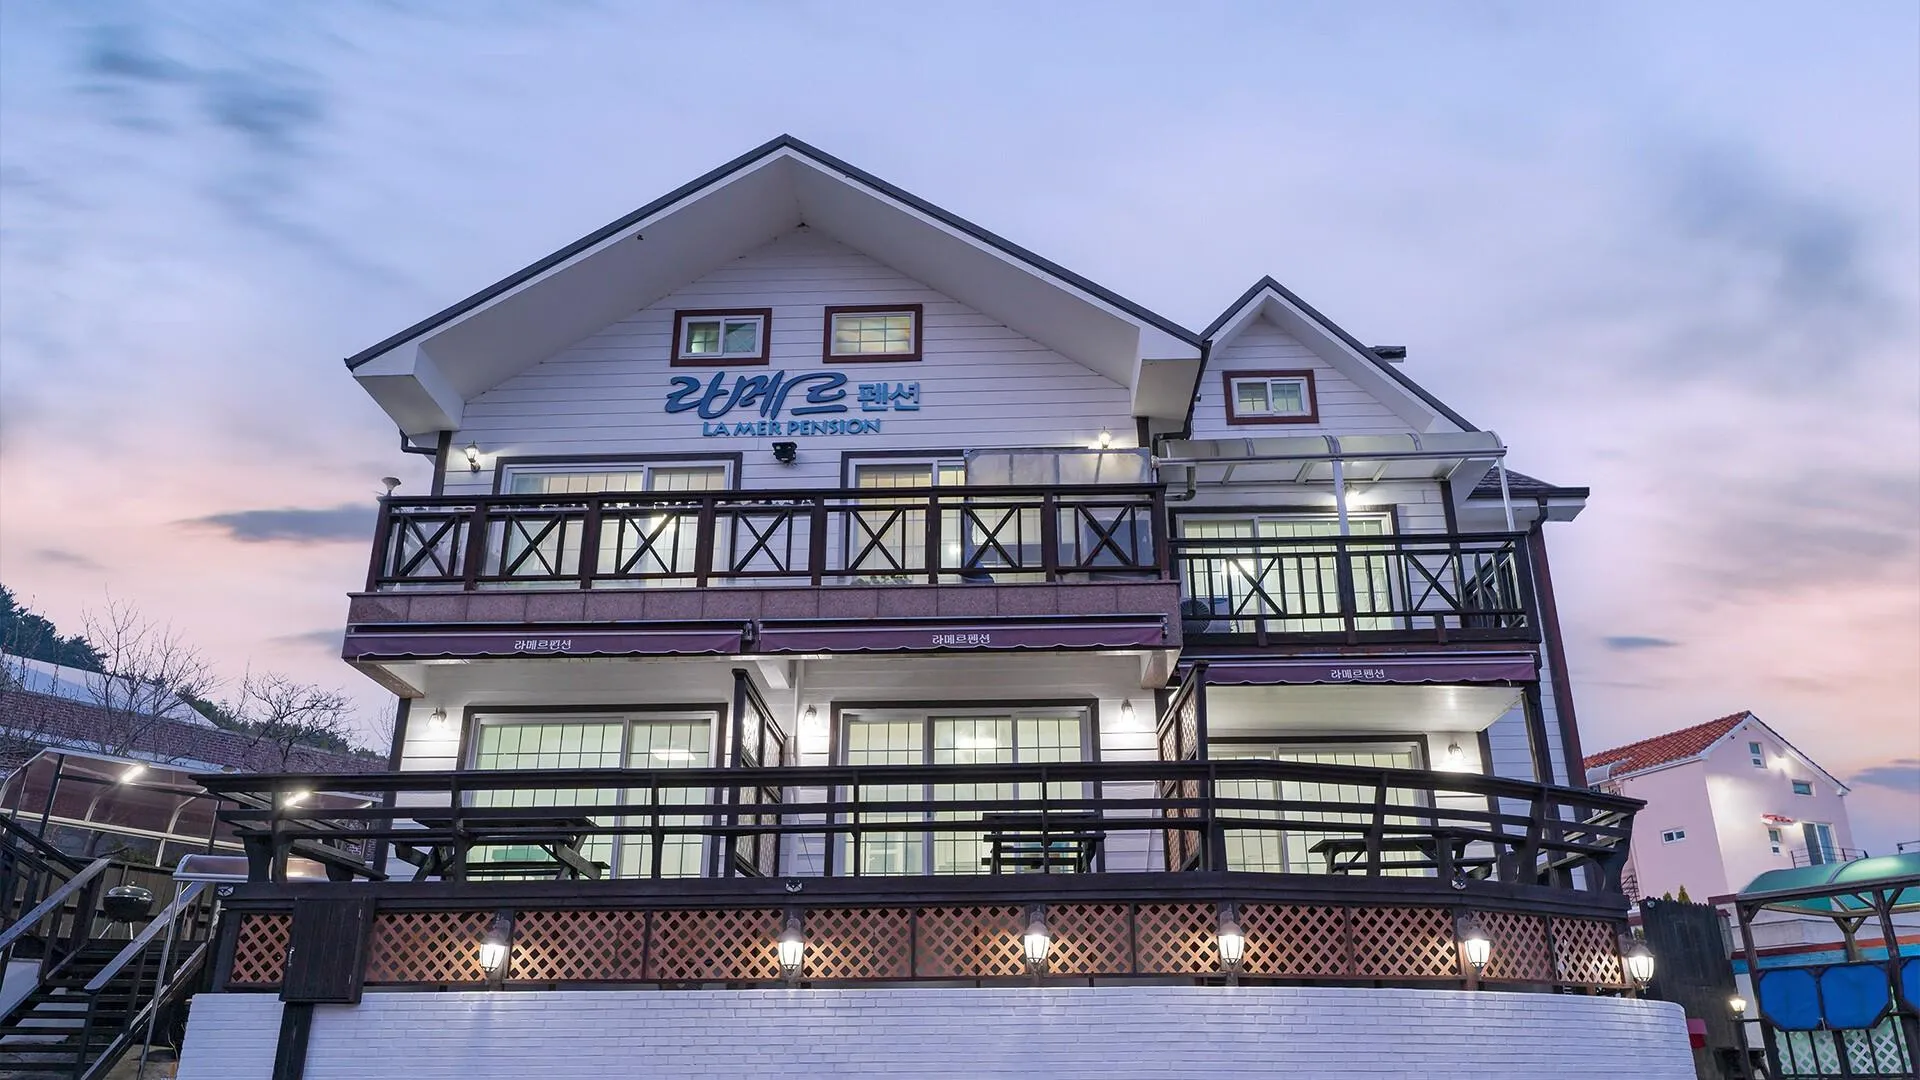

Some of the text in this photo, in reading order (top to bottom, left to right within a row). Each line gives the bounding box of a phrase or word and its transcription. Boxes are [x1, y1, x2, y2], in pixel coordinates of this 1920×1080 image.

[664, 370, 921, 420] 라메르 펜션
[702, 418, 881, 437] LA MER PENSION
